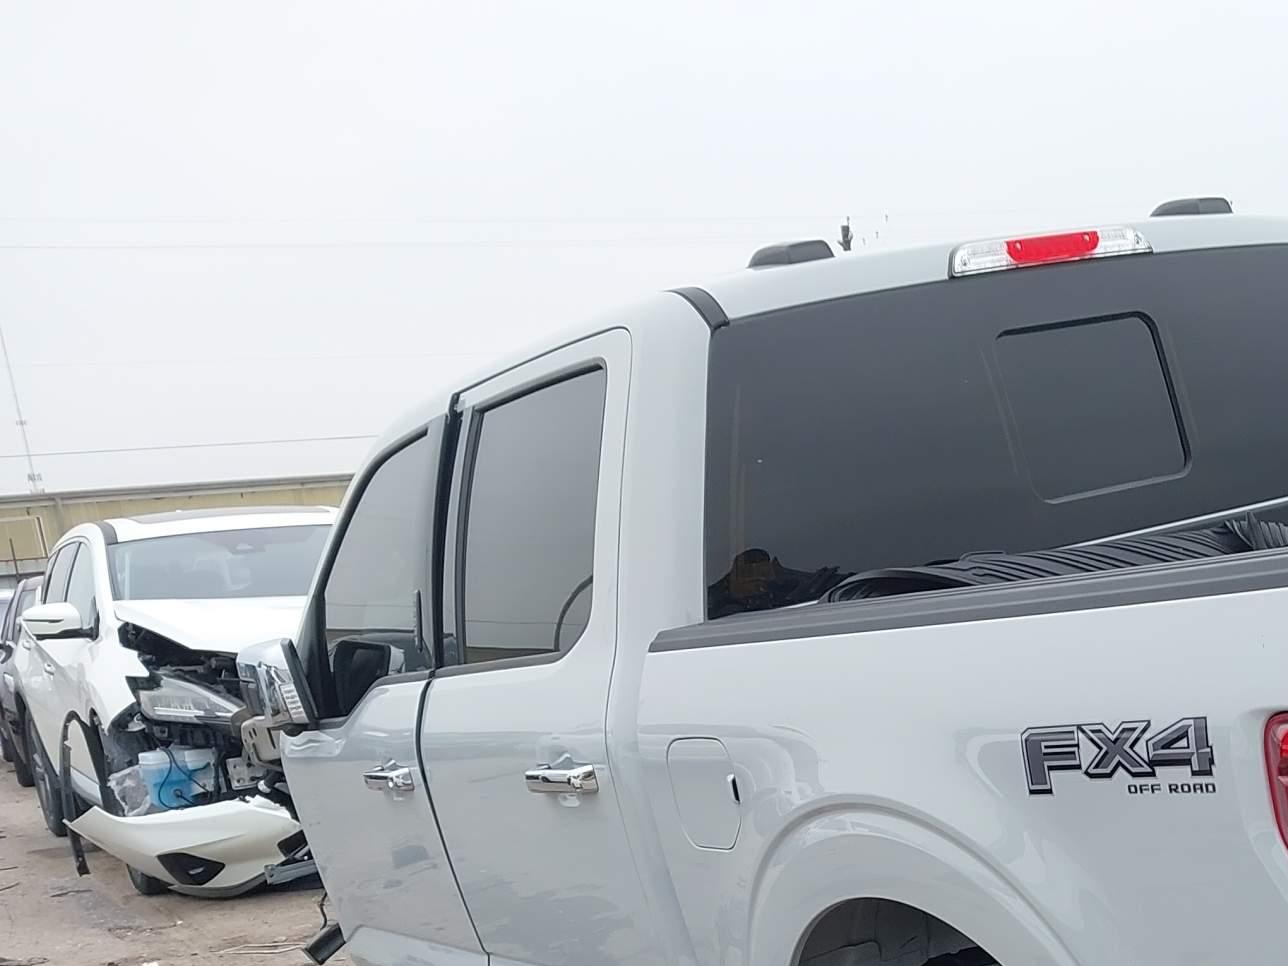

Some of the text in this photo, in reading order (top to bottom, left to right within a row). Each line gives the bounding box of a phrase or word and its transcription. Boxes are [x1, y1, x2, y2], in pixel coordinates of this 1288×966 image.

[1020, 716, 1215, 795] FX4
[1127, 782, 1217, 794] OFF ROAD
